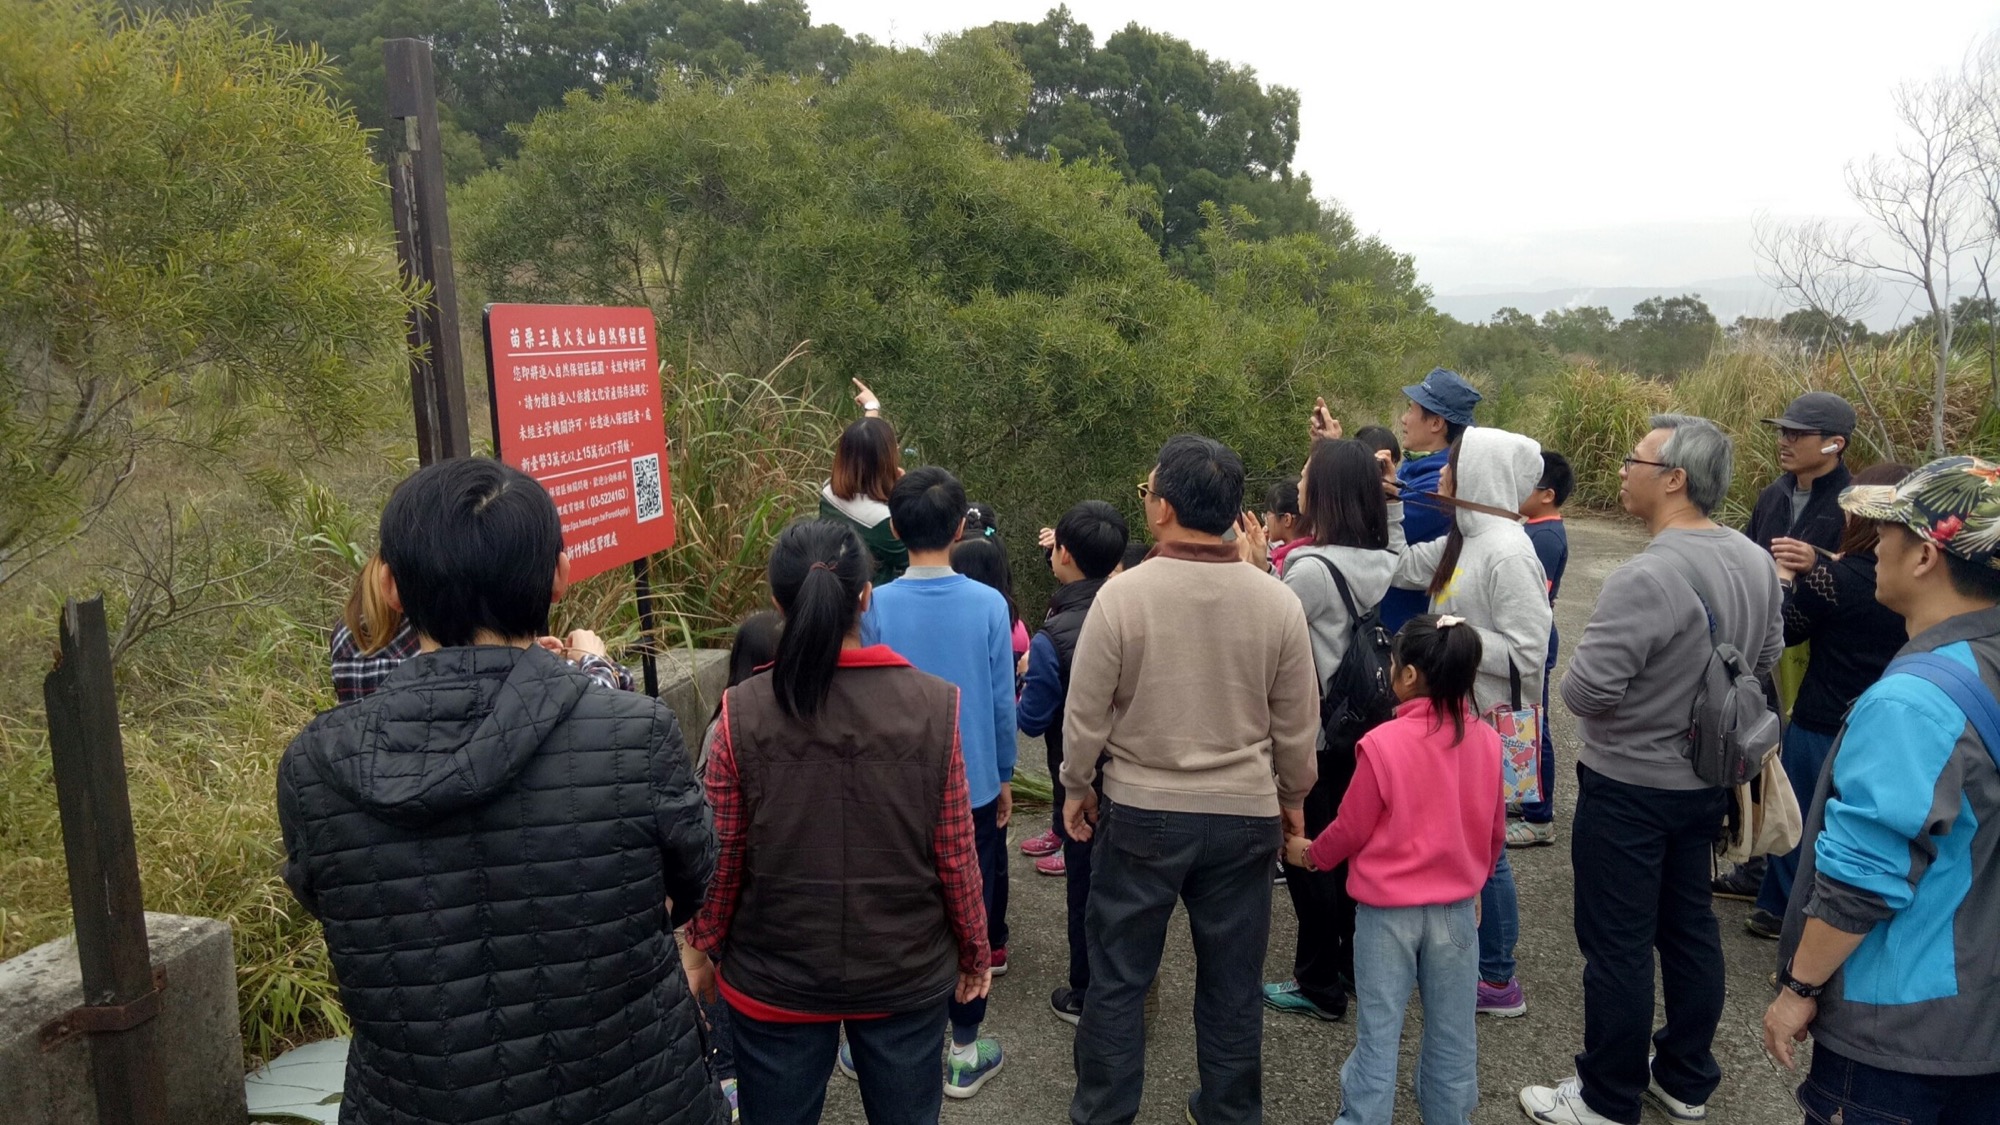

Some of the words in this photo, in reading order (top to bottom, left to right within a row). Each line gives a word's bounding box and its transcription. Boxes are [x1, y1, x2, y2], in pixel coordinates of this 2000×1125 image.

[510, 326, 647, 348] 苗栗三義火炎山自然保留區
